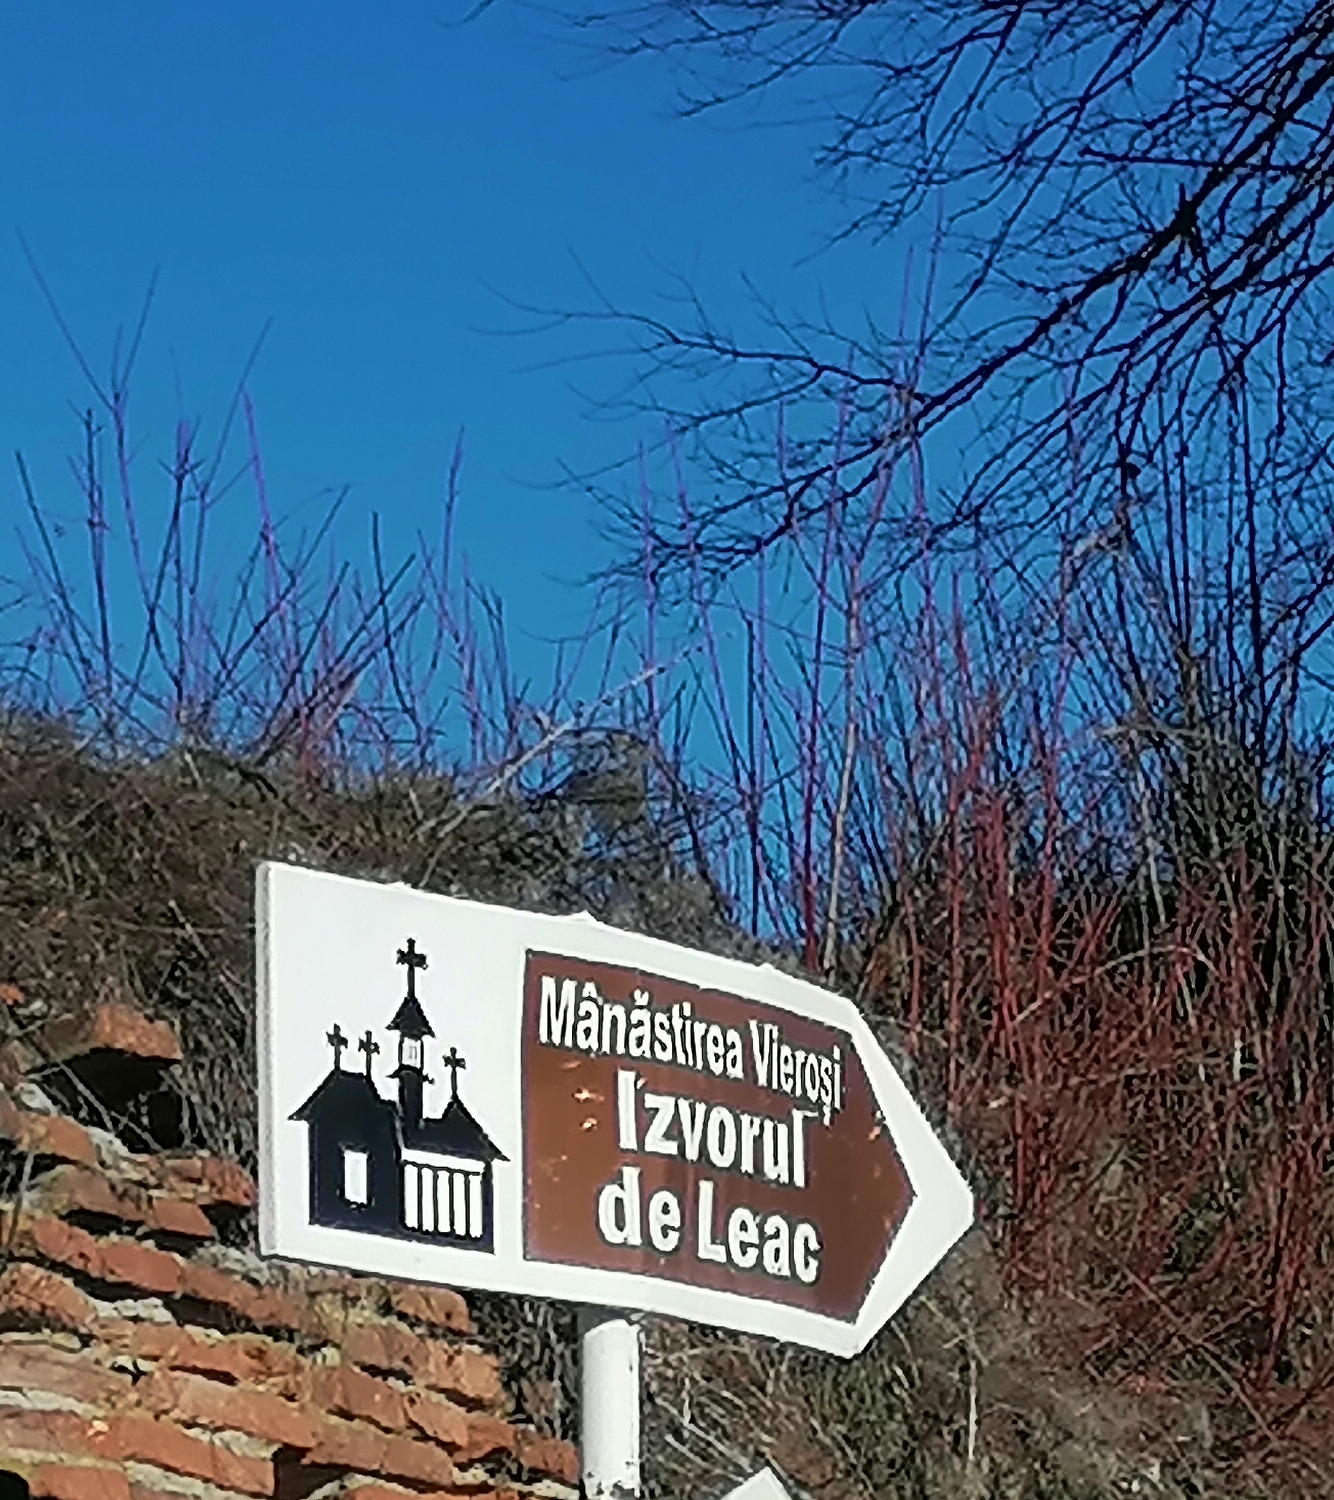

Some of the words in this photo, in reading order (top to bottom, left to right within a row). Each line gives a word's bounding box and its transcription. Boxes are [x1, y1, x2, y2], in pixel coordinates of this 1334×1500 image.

[538, 974, 744, 1080] Mânăstirea
[616, 1069, 809, 1189] Izvorul
[598, 1165, 682, 1252] de
[696, 1179, 824, 1284] Leac
